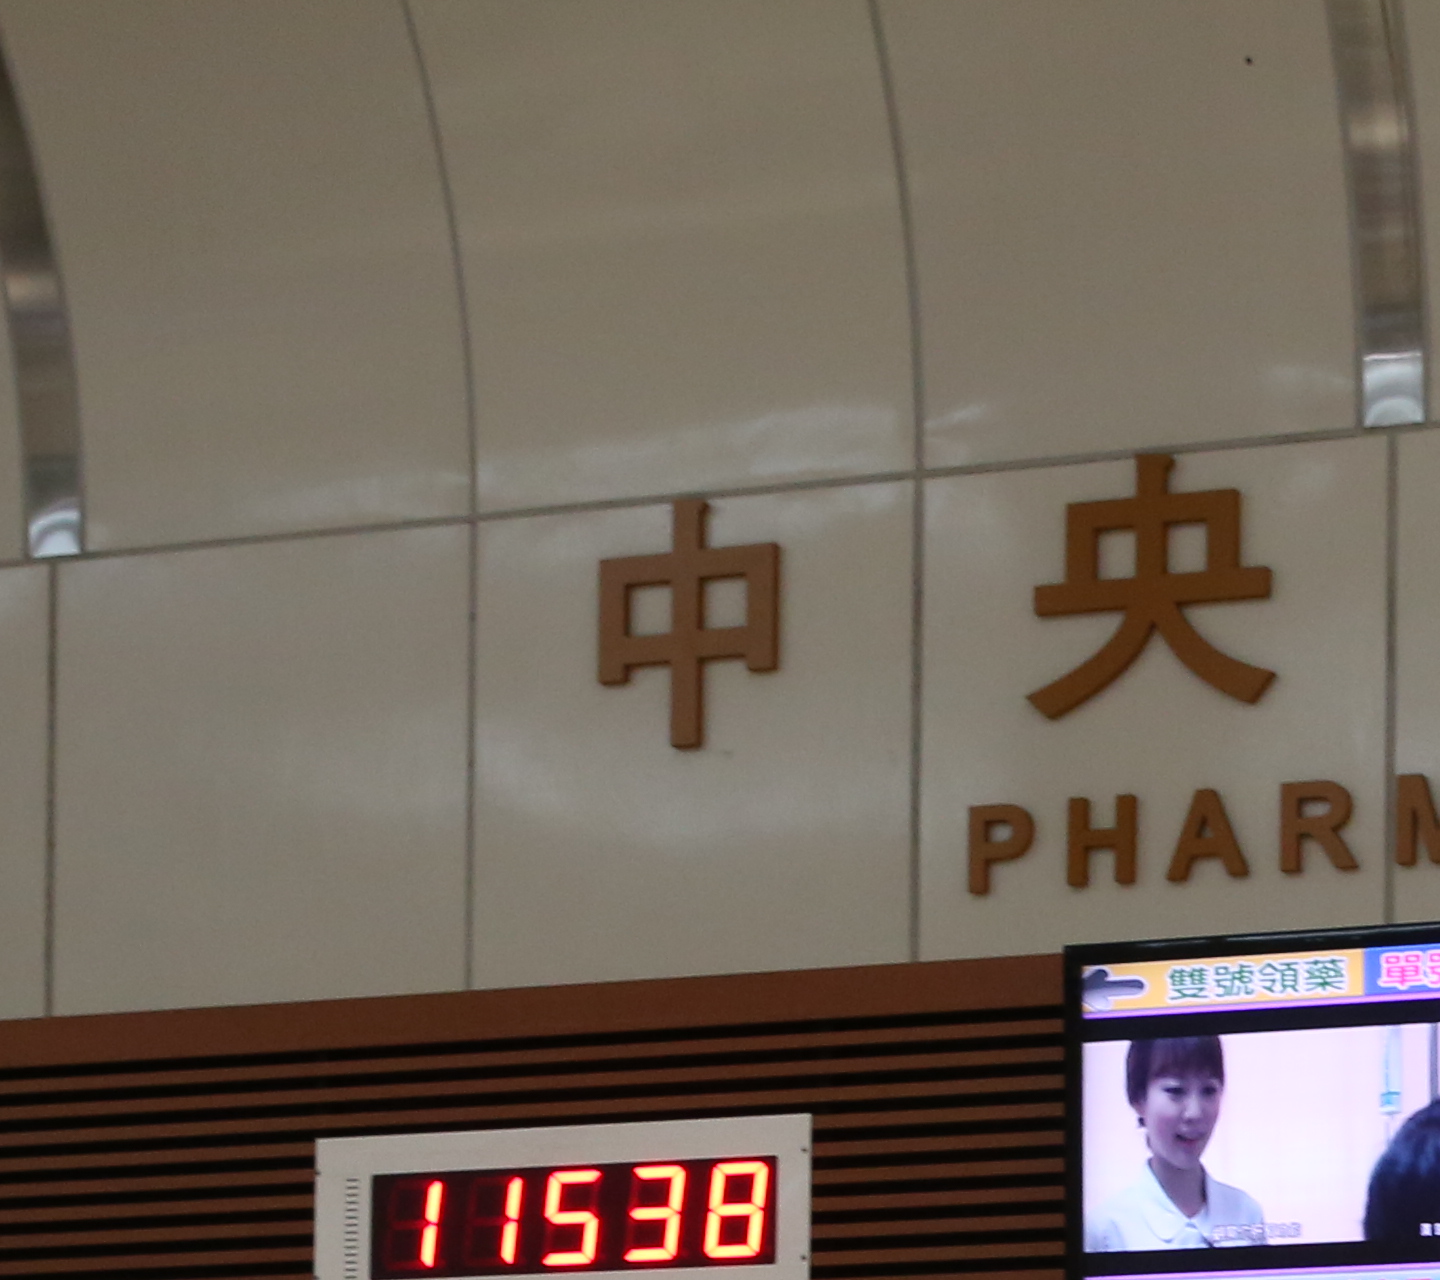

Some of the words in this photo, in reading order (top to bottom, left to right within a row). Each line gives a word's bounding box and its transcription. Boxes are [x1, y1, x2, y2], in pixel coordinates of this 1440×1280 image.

[1166, 956, 1350, 1001] 雙號領藥
[415, 1159, 772, 1267] 11538
